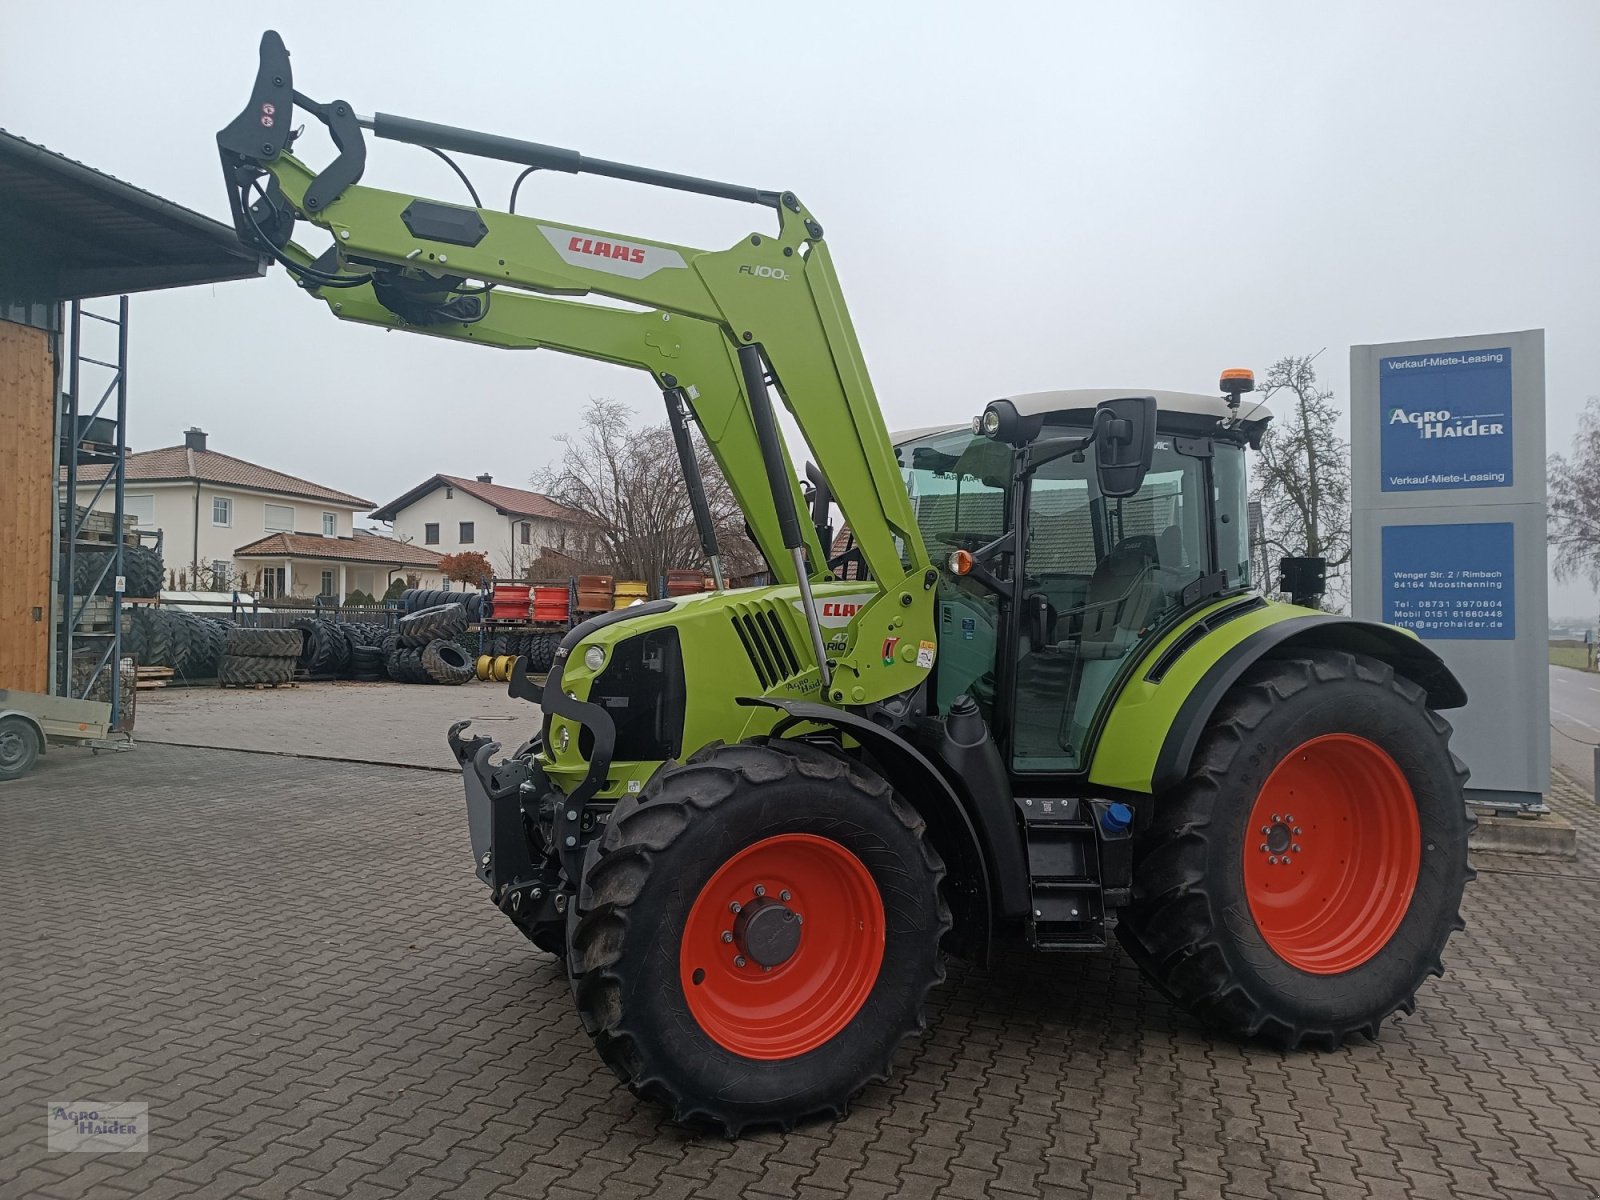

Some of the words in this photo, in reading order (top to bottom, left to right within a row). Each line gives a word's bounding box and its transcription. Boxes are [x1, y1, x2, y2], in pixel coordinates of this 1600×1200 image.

[568, 236, 646, 264] CLAAS
[1388, 353, 1503, 370] Verkauf-Miete-Leasing
[1390, 472, 1505, 485] Verkauf-Miete-Leasing
[1394, 571, 1427, 580] Wenger
[1430, 571, 1445, 579] Str.
[1448, 571, 1454, 579] 2
[1429, 580, 1502, 589] Moosthenning
[822, 603, 863, 617] CLA
[1394, 620, 1503, 629] info@agrohaider.de
[832, 633, 849, 641] 47
[823, 642, 847, 651] RIO
